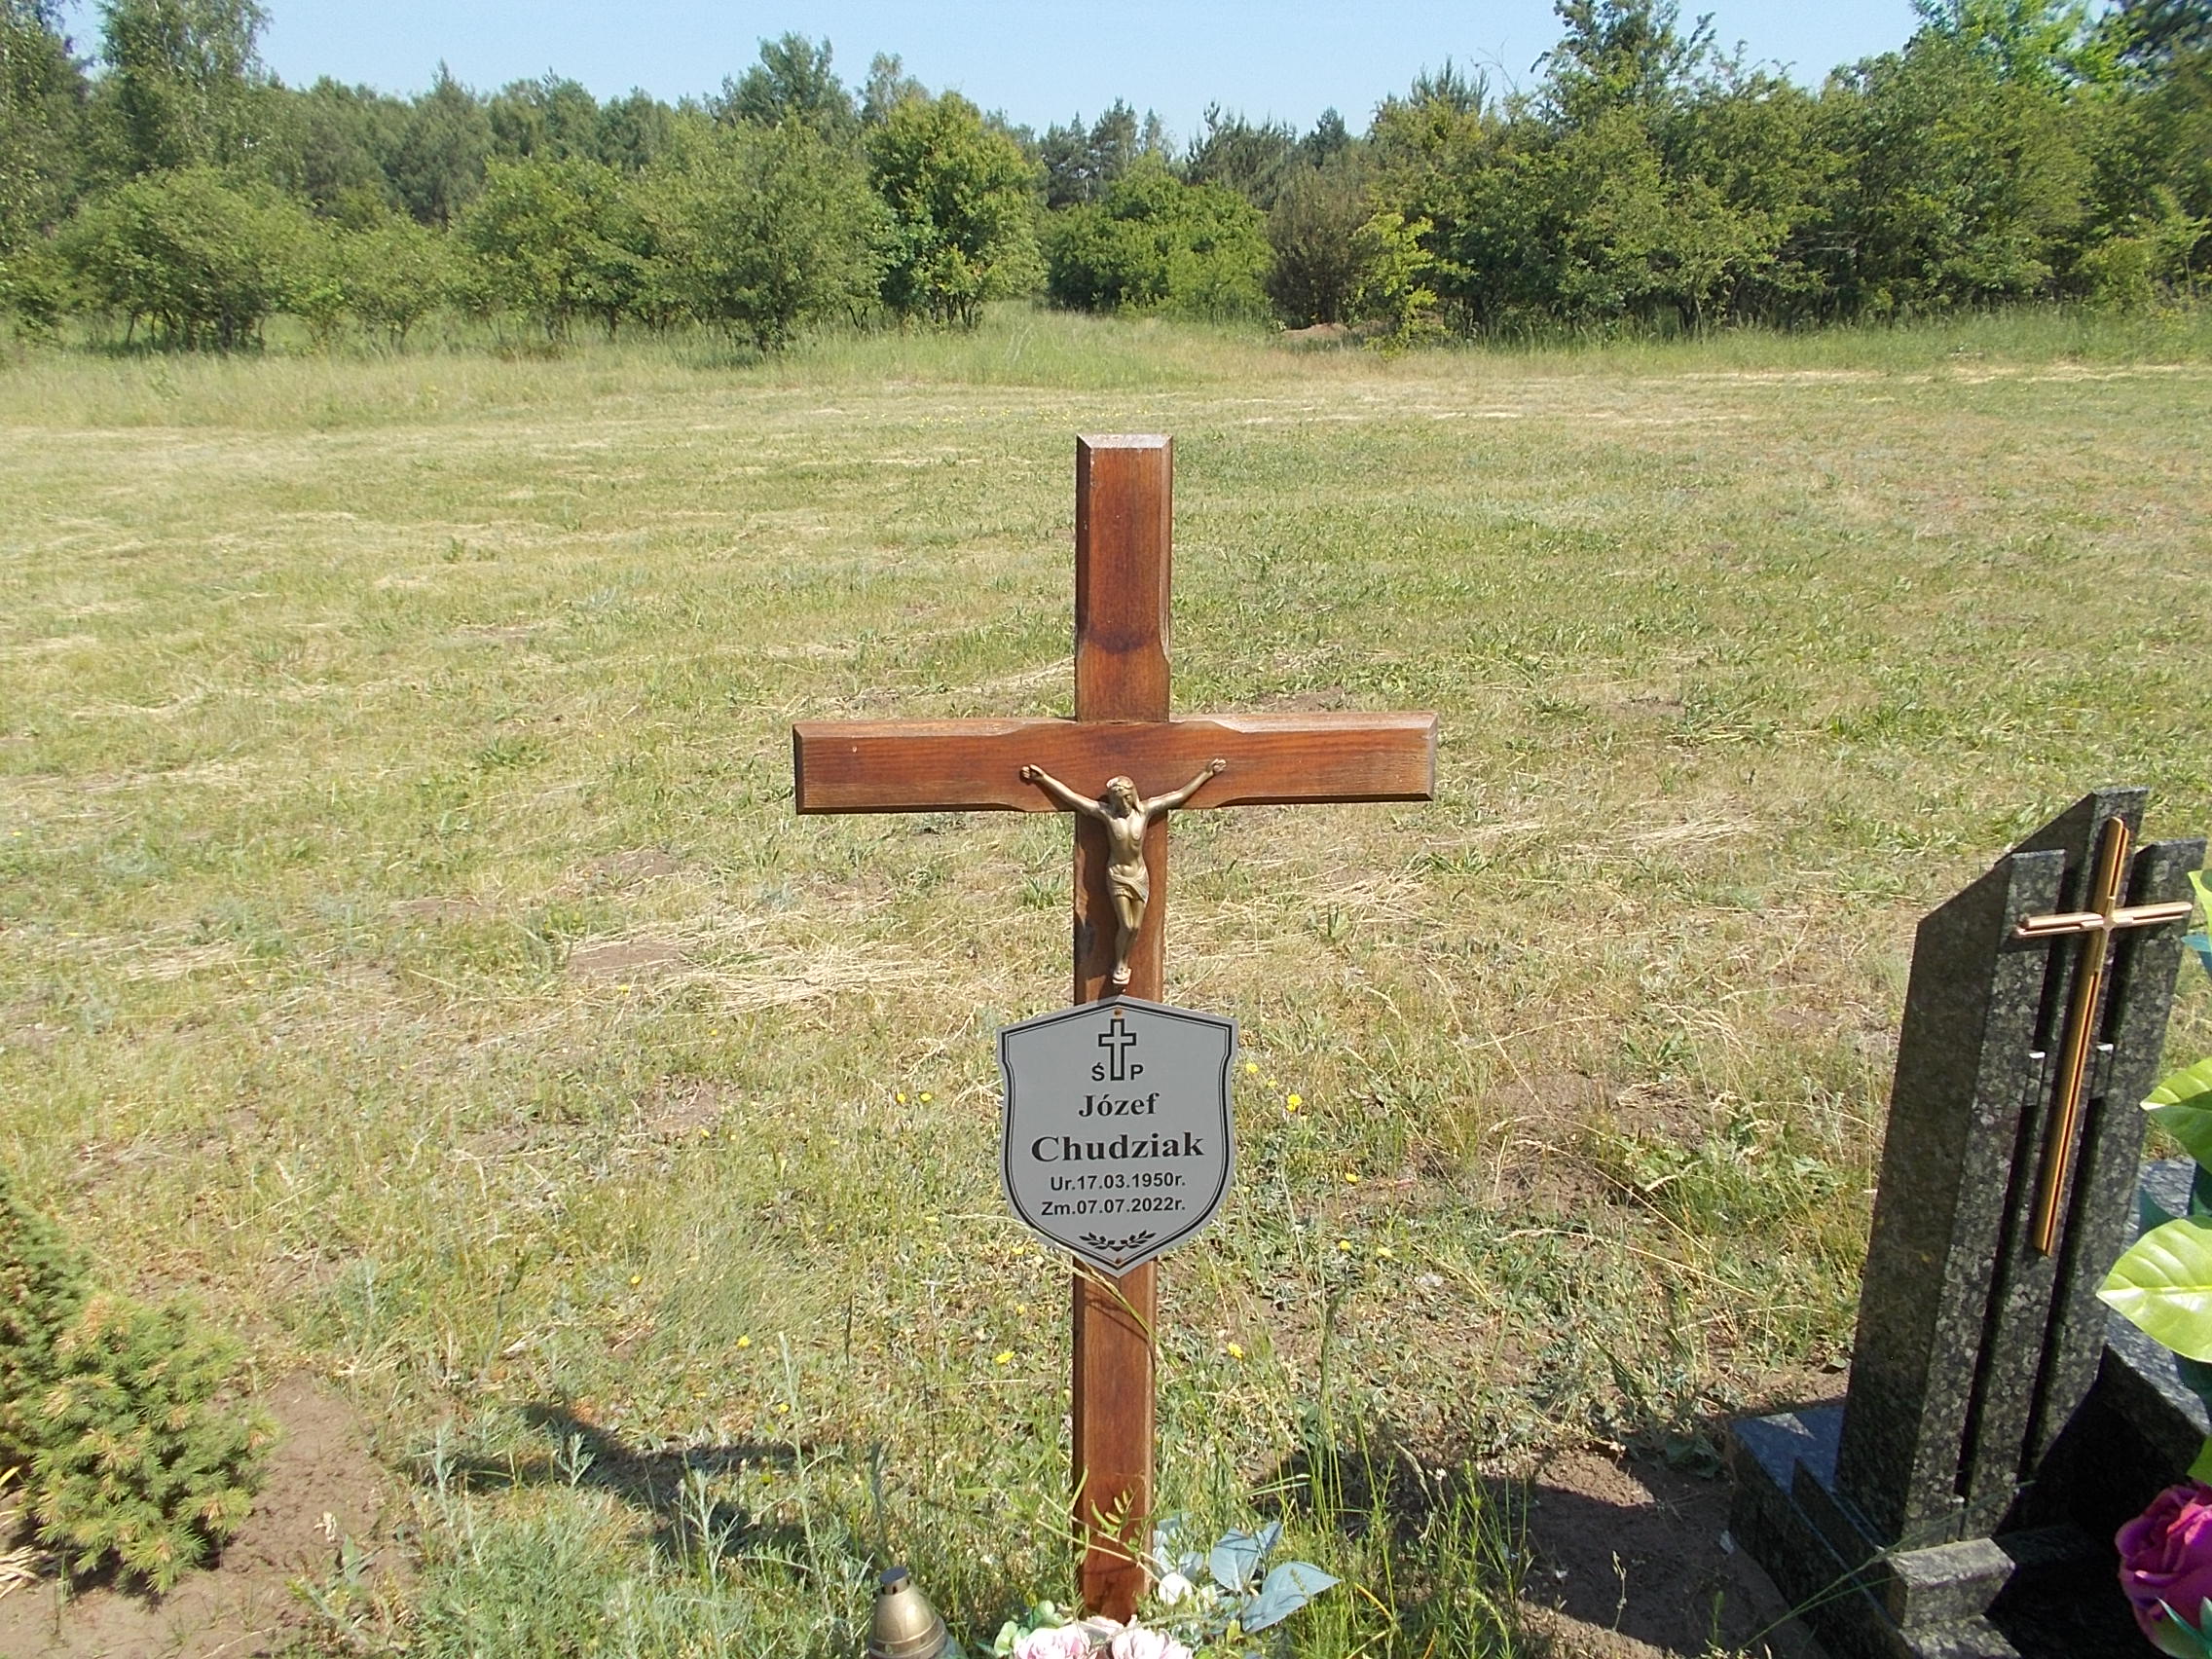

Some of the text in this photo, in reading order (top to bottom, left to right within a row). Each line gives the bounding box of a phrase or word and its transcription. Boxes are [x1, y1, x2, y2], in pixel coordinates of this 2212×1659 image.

[1091, 1062, 1144, 1081] Ś P
[1078, 1092, 1161, 1118] Józef
[1031, 1131, 1205, 1162] Chudziak
[1051, 1172, 1187, 1191] Ur.17.03.1950r.
[1041, 1197, 1186, 1216] Zm.07.07.2022r.
